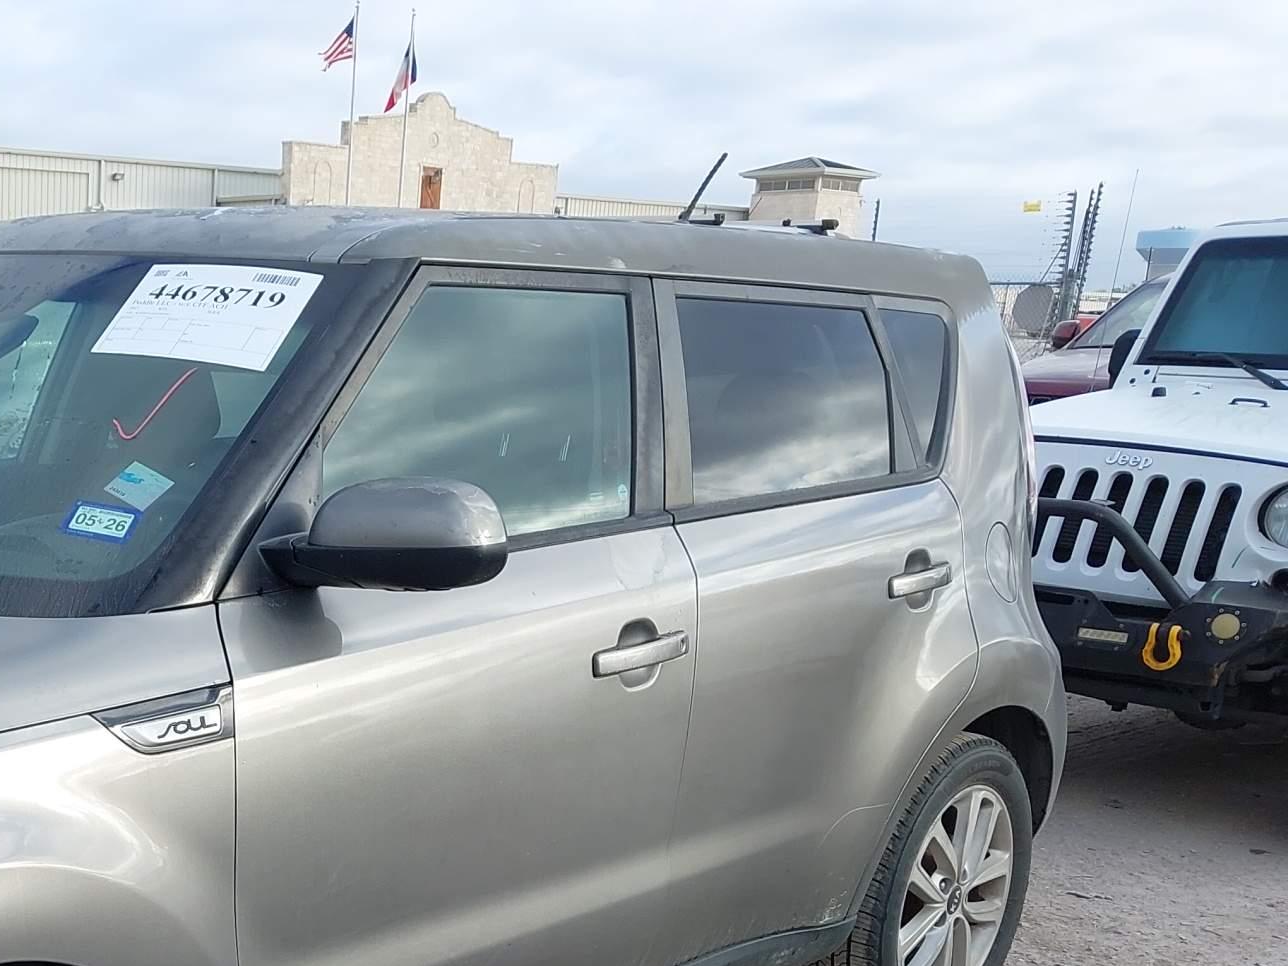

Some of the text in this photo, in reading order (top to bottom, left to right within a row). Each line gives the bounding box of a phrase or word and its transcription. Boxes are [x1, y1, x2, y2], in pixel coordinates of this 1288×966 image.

[149, 284, 286, 309] 44678719
[1105, 450, 1153, 471] Jeep
[74, 512, 128, 532] 05 26
[157, 716, 218, 739] SOUL
